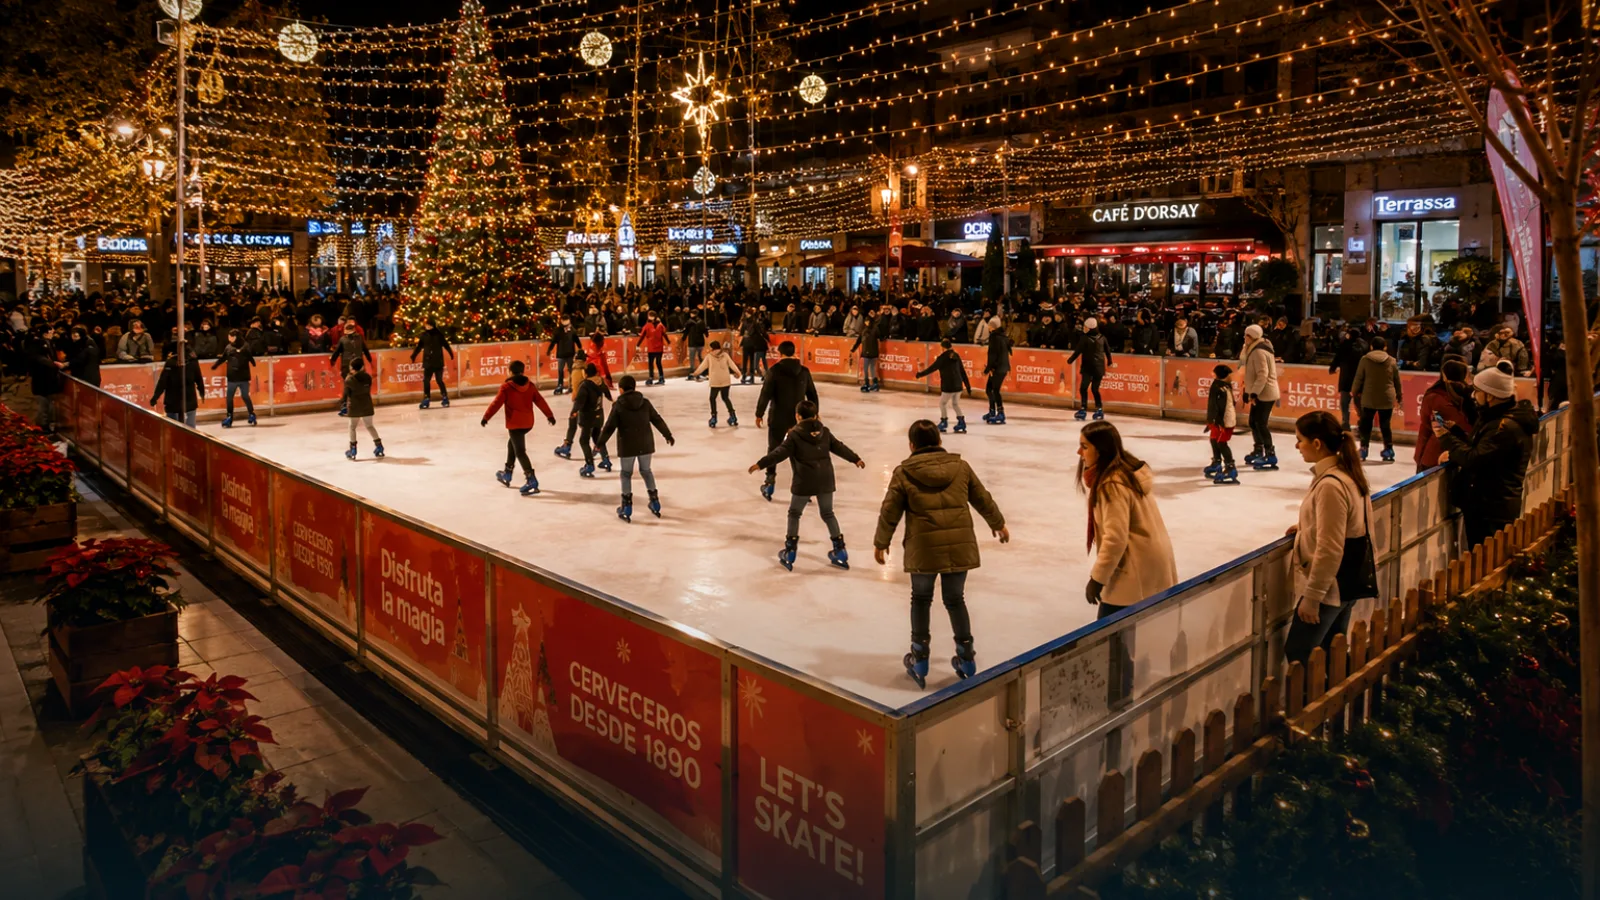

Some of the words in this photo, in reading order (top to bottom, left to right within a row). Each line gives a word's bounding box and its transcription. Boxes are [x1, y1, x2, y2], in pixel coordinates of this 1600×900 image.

[1092, 204, 1129, 222] CAFÉ
[1133, 203, 1199, 221] D'ORSAY
[1374, 196, 1456, 212] Terrassa
[1287, 394, 1341, 411] SKATE!
[221, 472, 252, 508] Disfruta
[221, 500, 229, 519] la
[229, 504, 254, 535] magia
[381, 548, 444, 608] Disfruta
[381, 581, 394, 617] la
[396, 595, 445, 646] magia
[569, 660, 701, 751] CERVECEROS
[570, 693, 637, 755] DESDE
[643, 733, 701, 790] 1890
[759, 755, 846, 831] LET'S
[753, 795, 864, 887] SKATE!
